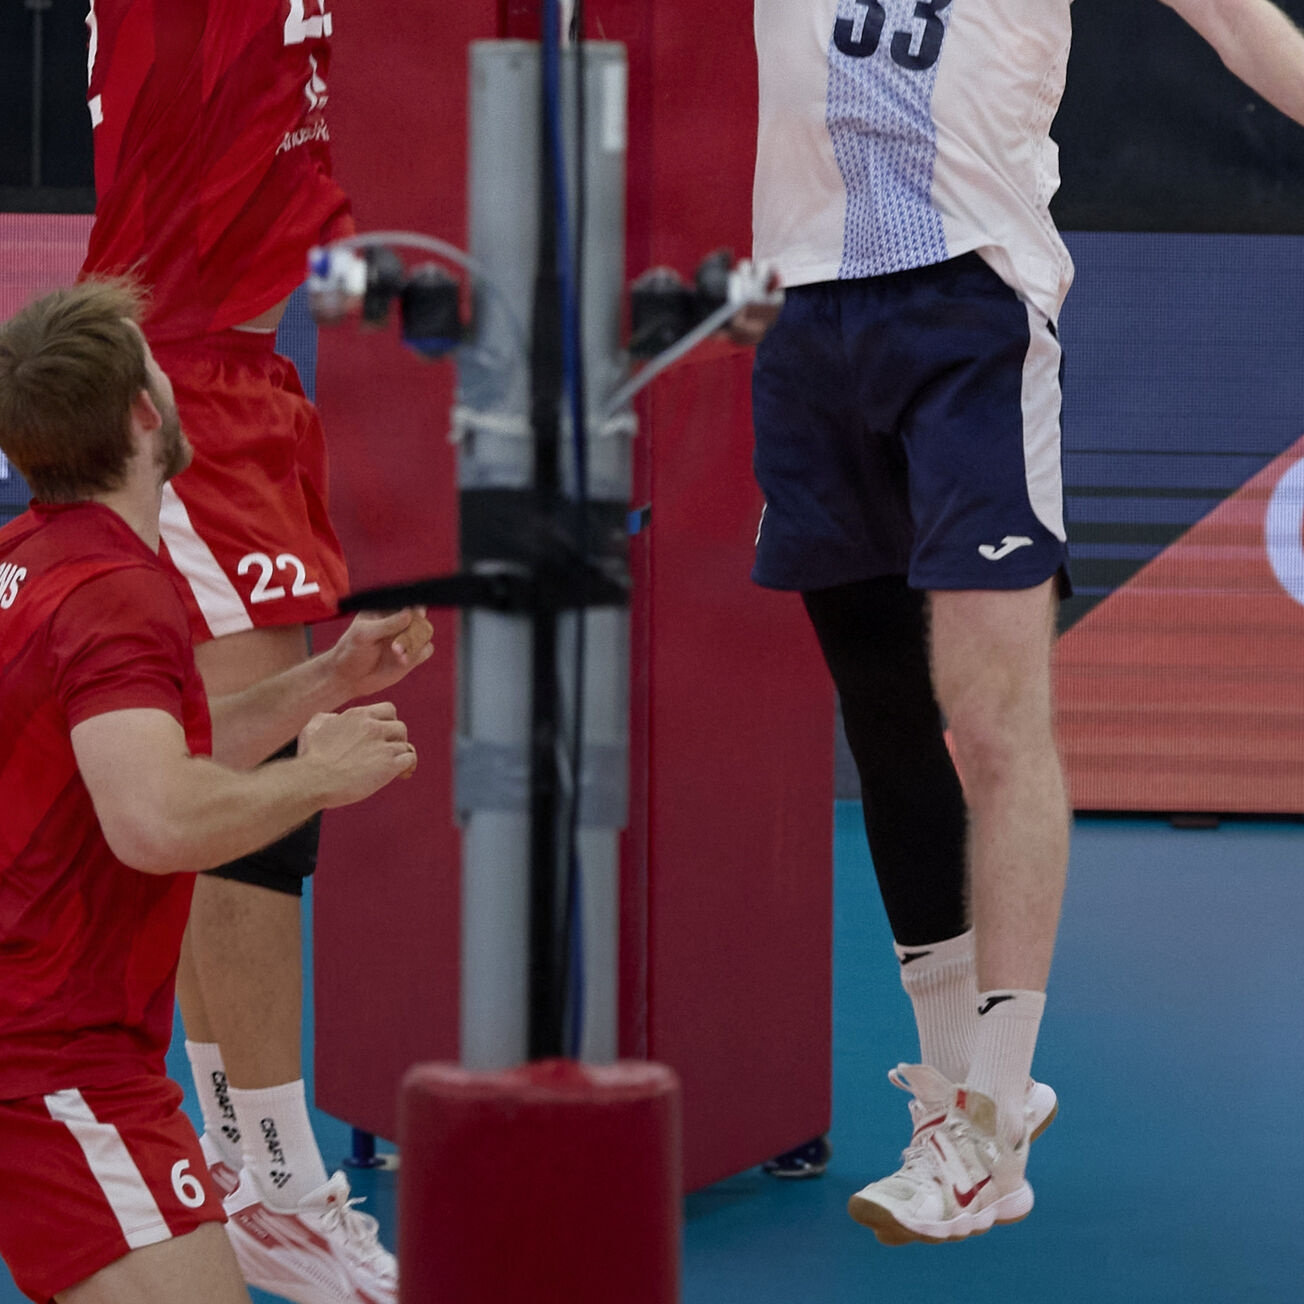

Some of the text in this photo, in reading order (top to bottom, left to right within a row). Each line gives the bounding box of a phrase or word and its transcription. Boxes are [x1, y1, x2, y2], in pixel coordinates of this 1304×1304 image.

[237, 552, 320, 604] 22
[211, 1070, 237, 1123] CRAFT
[260, 1117, 287, 1166] CRAFT
[170, 1158, 206, 1209] 6
